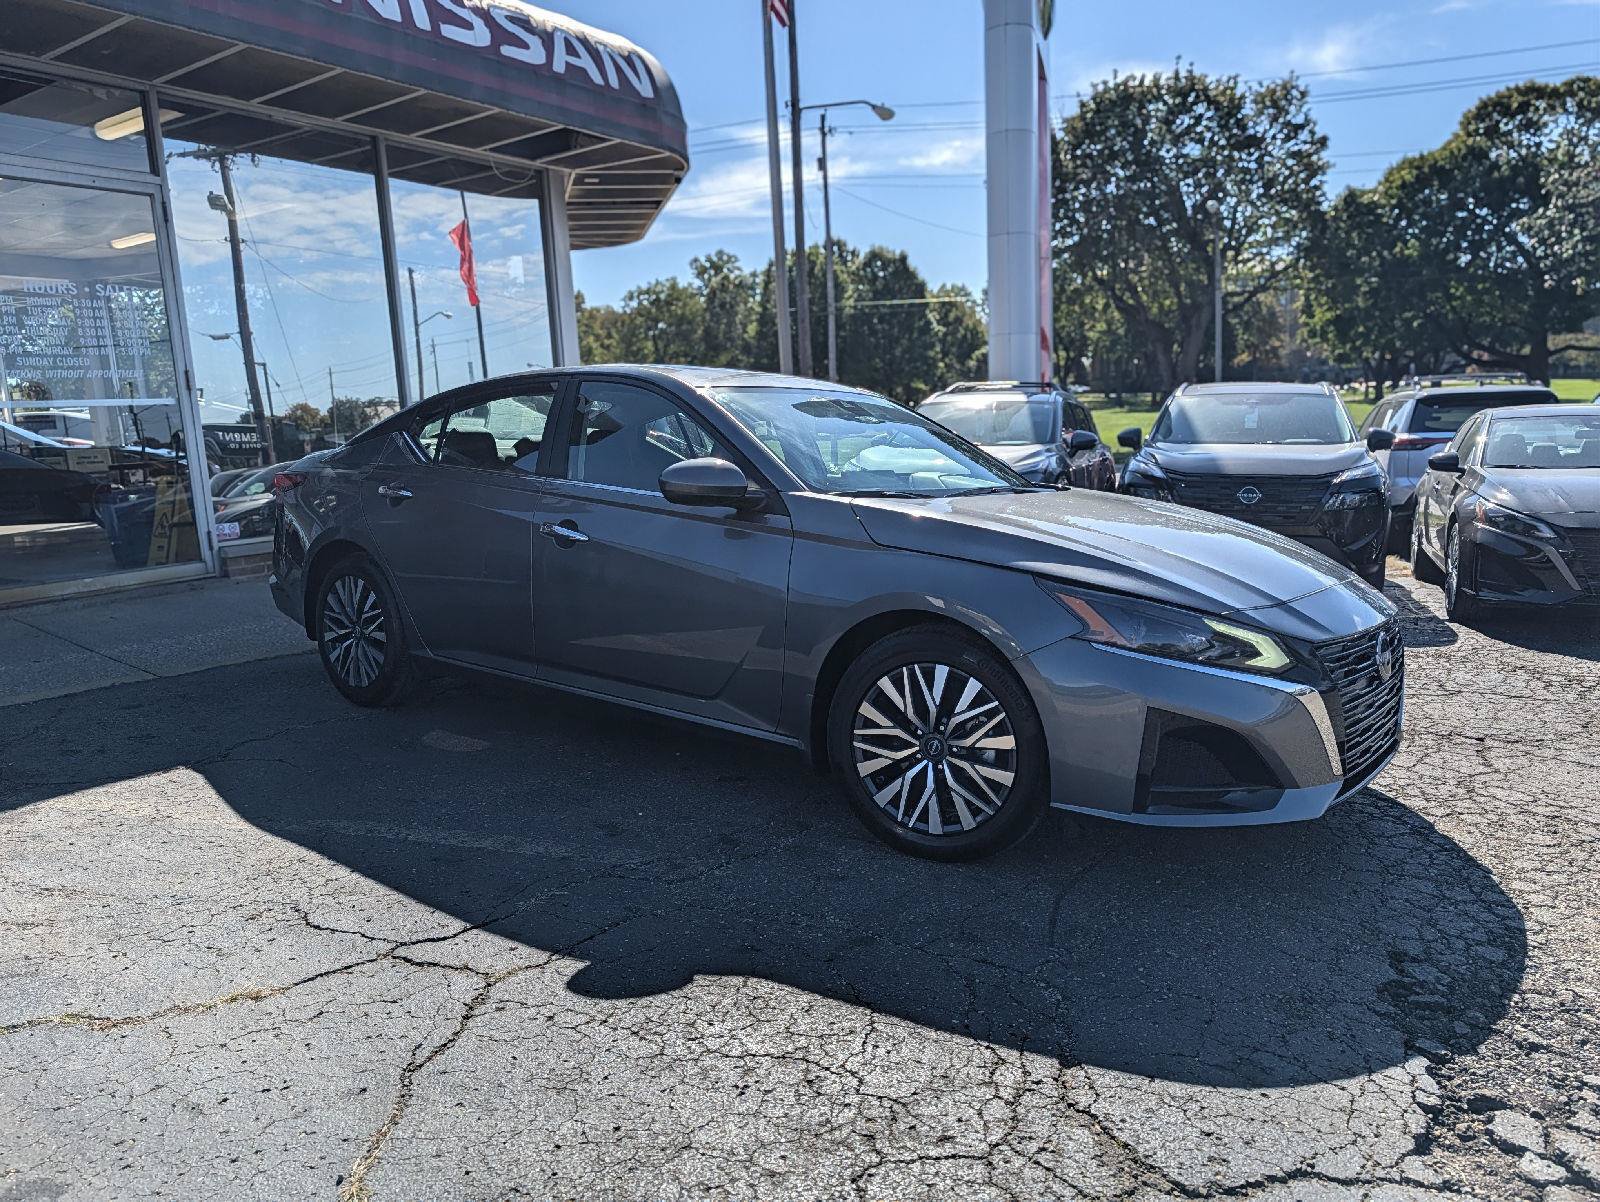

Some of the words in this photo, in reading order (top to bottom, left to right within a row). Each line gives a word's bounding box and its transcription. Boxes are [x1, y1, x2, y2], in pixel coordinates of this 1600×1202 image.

[330, 0, 655, 99] ISSAN
[23, 281, 78, 294] HOURS
[95, 283, 139, 297] SALE
[27, 307, 64, 317] TUESDY
[75, 309, 93, 317] 9:00
[77, 319, 95, 327] 9:00
[5, 326, 19, 335] PM
[78, 328, 96, 336] 8:30
[79, 338, 97, 346] 9:00
[81, 347, 99, 356] 9:00
[16, 357, 53, 366] SUNDAY
[56, 357, 90, 367] CLOSED
[45, 369, 85, 378] WITHOUT
[86, 369, 144, 379] APPOITMENT
